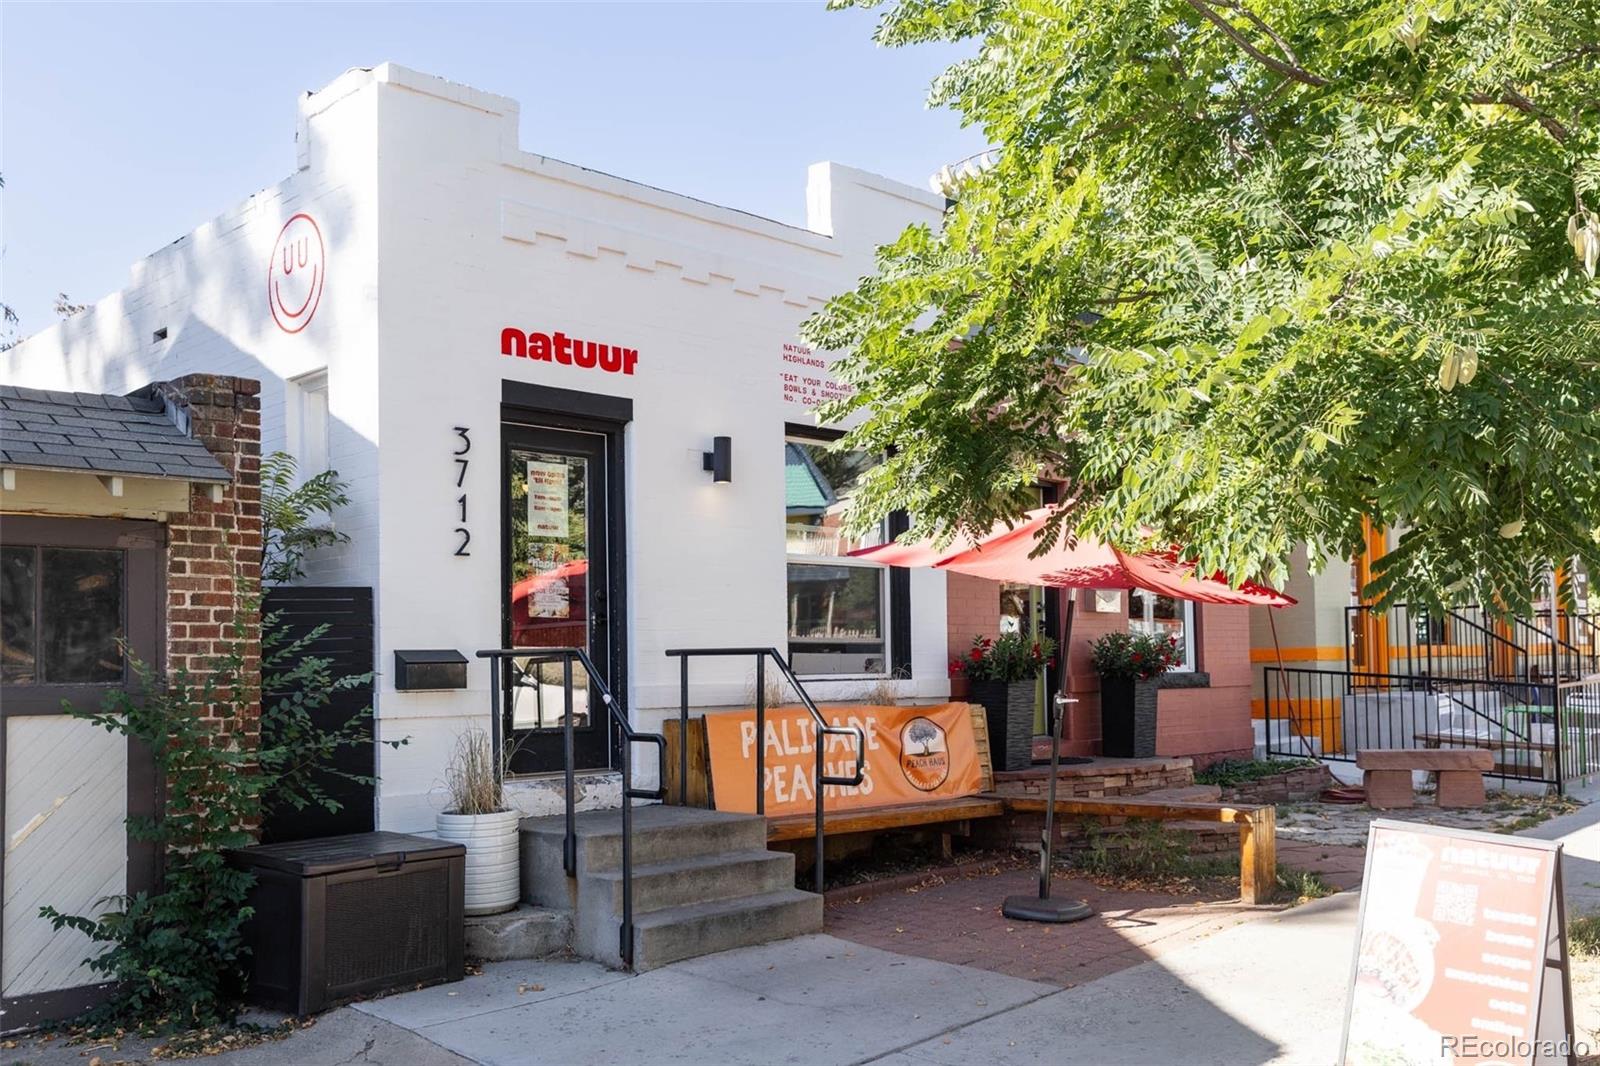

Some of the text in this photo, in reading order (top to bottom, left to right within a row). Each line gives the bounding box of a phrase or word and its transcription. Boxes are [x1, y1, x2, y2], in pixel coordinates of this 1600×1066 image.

[501, 327, 638, 375] natuur
[783, 344, 811, 355] NATUUR
[783, 354, 825, 368] HIGHLANDS
[803, 377, 821, 386] YOUR
[784, 384, 807, 395] BOWLS
[453, 426, 471, 556] 3712
[928, 757, 945, 767] HAUS
